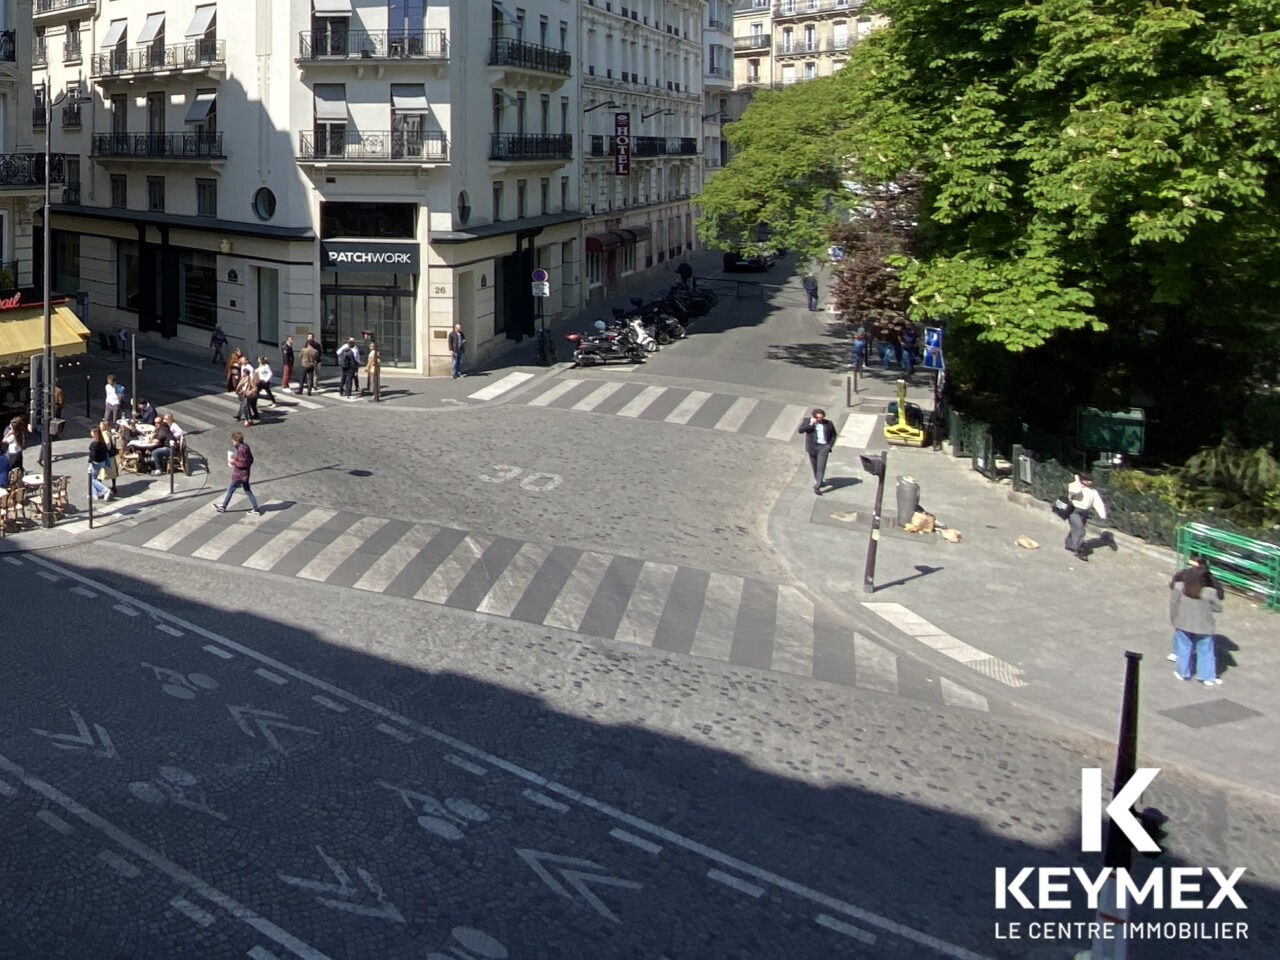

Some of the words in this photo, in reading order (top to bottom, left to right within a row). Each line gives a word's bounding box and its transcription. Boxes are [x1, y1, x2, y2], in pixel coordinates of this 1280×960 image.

[616, 126, 629, 173] HOTEL
[328, 251, 412, 264] PATCHWORK
[434, 286, 446, 294] 26
